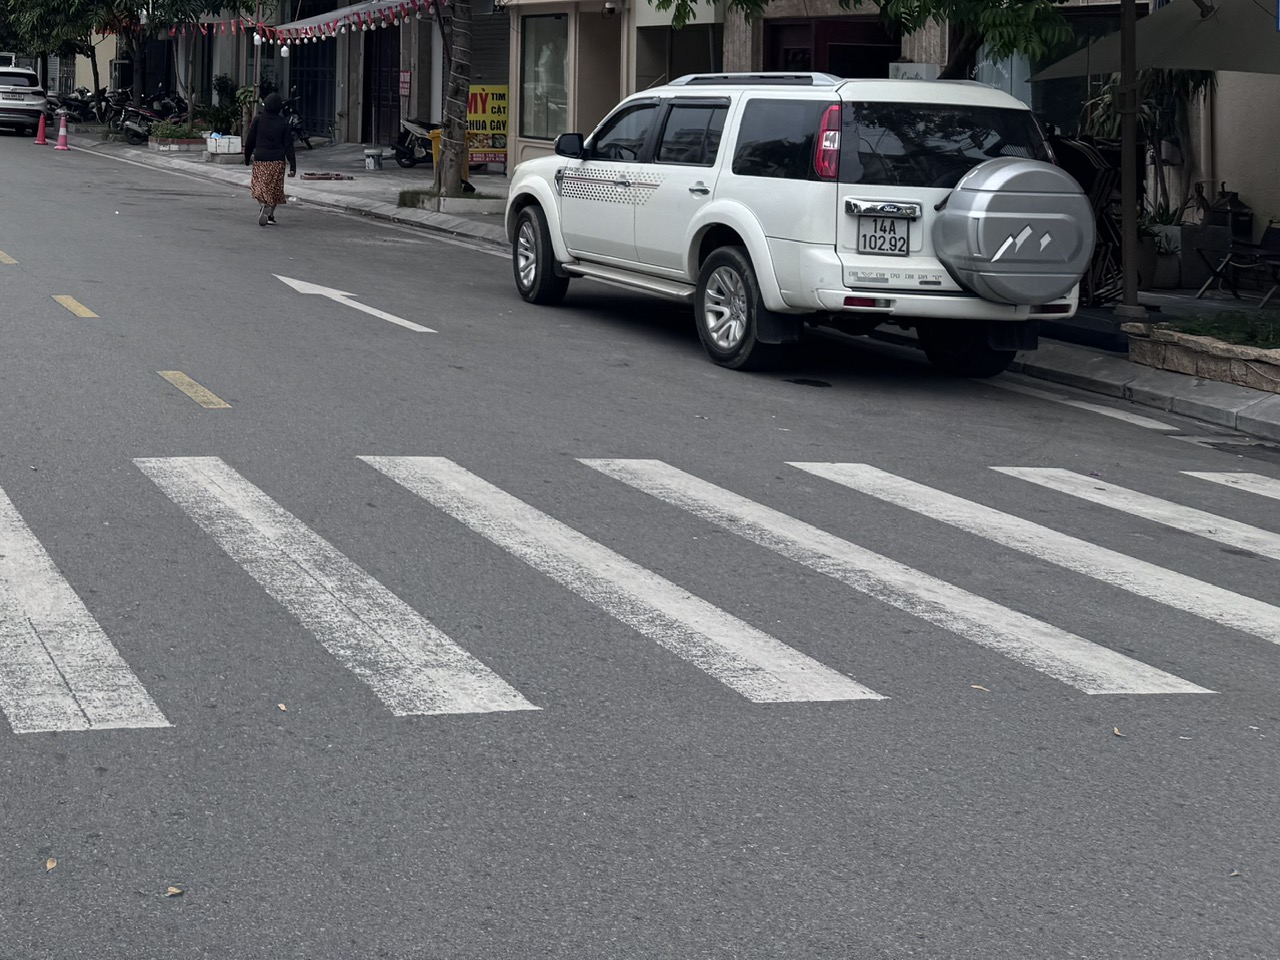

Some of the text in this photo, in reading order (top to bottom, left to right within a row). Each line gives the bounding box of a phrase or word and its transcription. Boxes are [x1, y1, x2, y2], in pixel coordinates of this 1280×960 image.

[490, 93, 506, 101] TIM
[489, 119, 507, 131] CAY
[883, 205, 898, 213] Ford
[872, 219, 897, 236] 14A
[861, 234, 907, 253] 102.92
